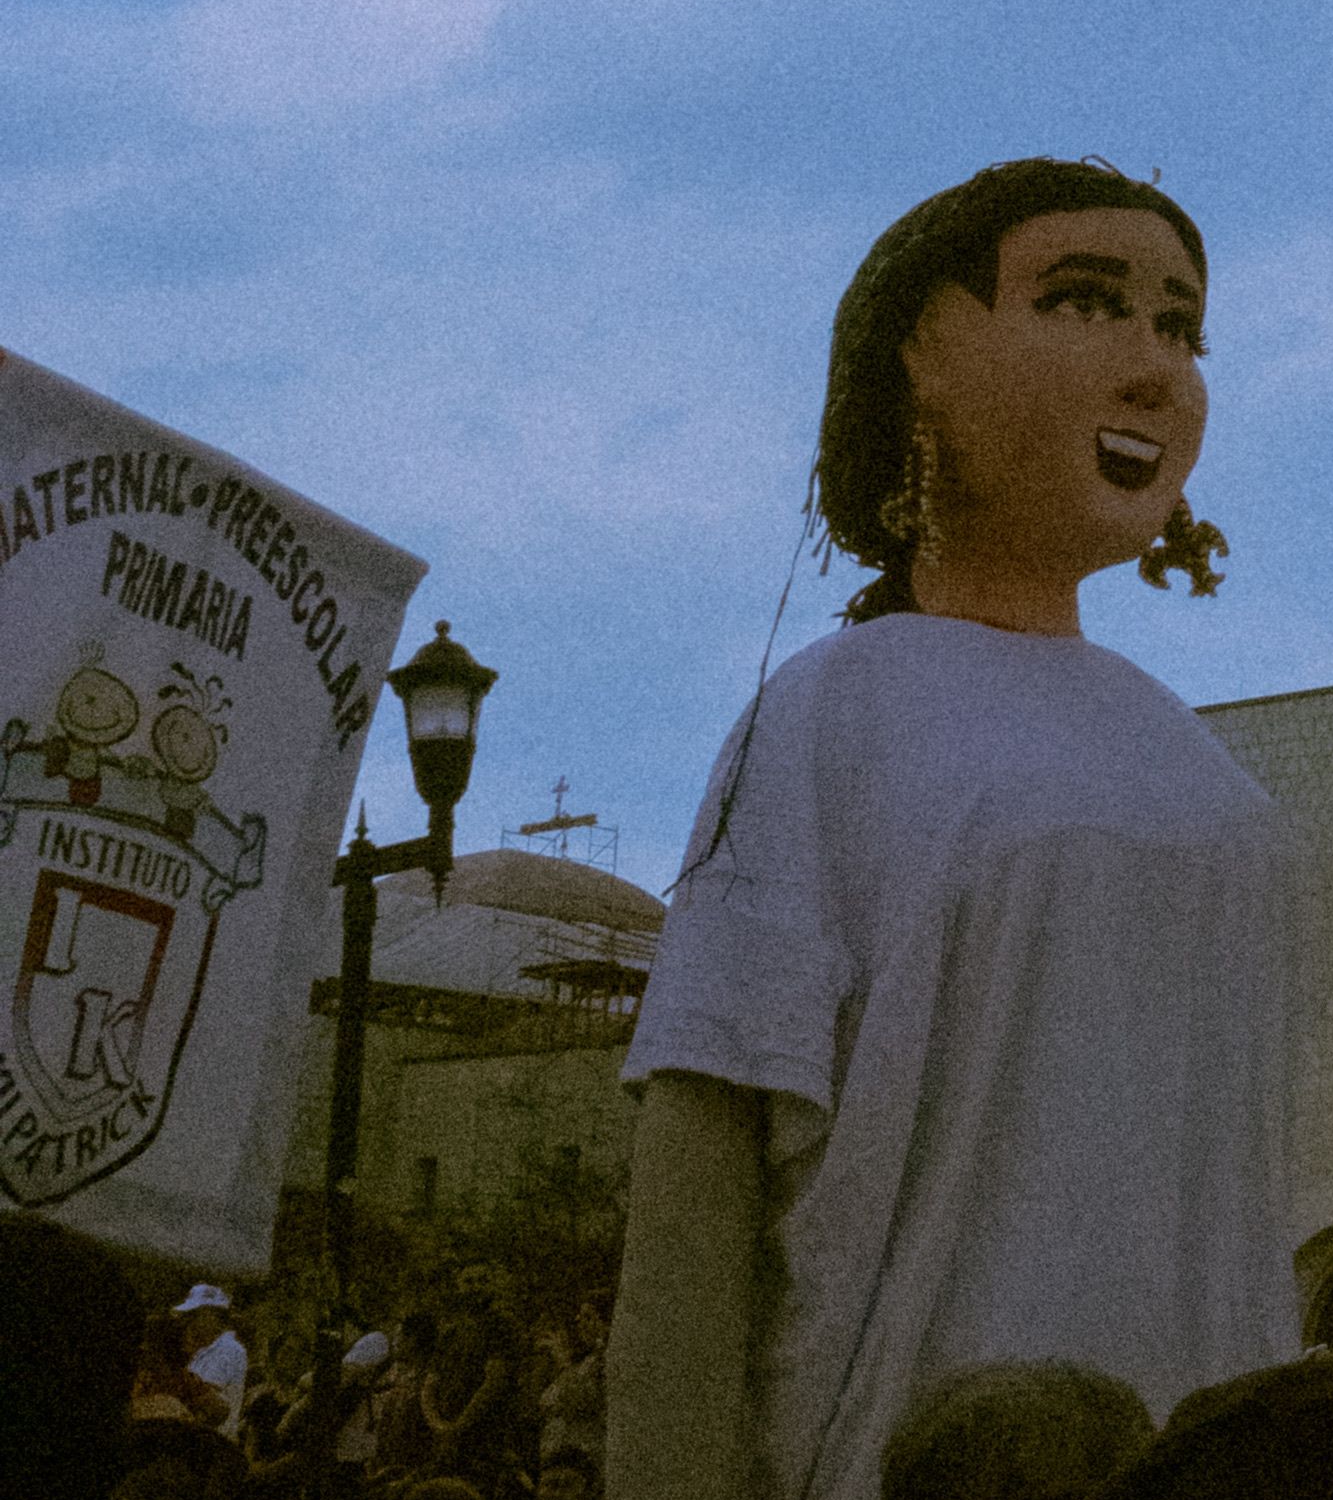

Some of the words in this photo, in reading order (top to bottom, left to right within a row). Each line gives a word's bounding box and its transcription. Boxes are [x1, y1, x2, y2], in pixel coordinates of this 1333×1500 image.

[101, 529, 252, 661] PRIMARIA
[207, 477, 369, 751] PREESCOLAR
[38, 818, 192, 899] INSTITUTO
